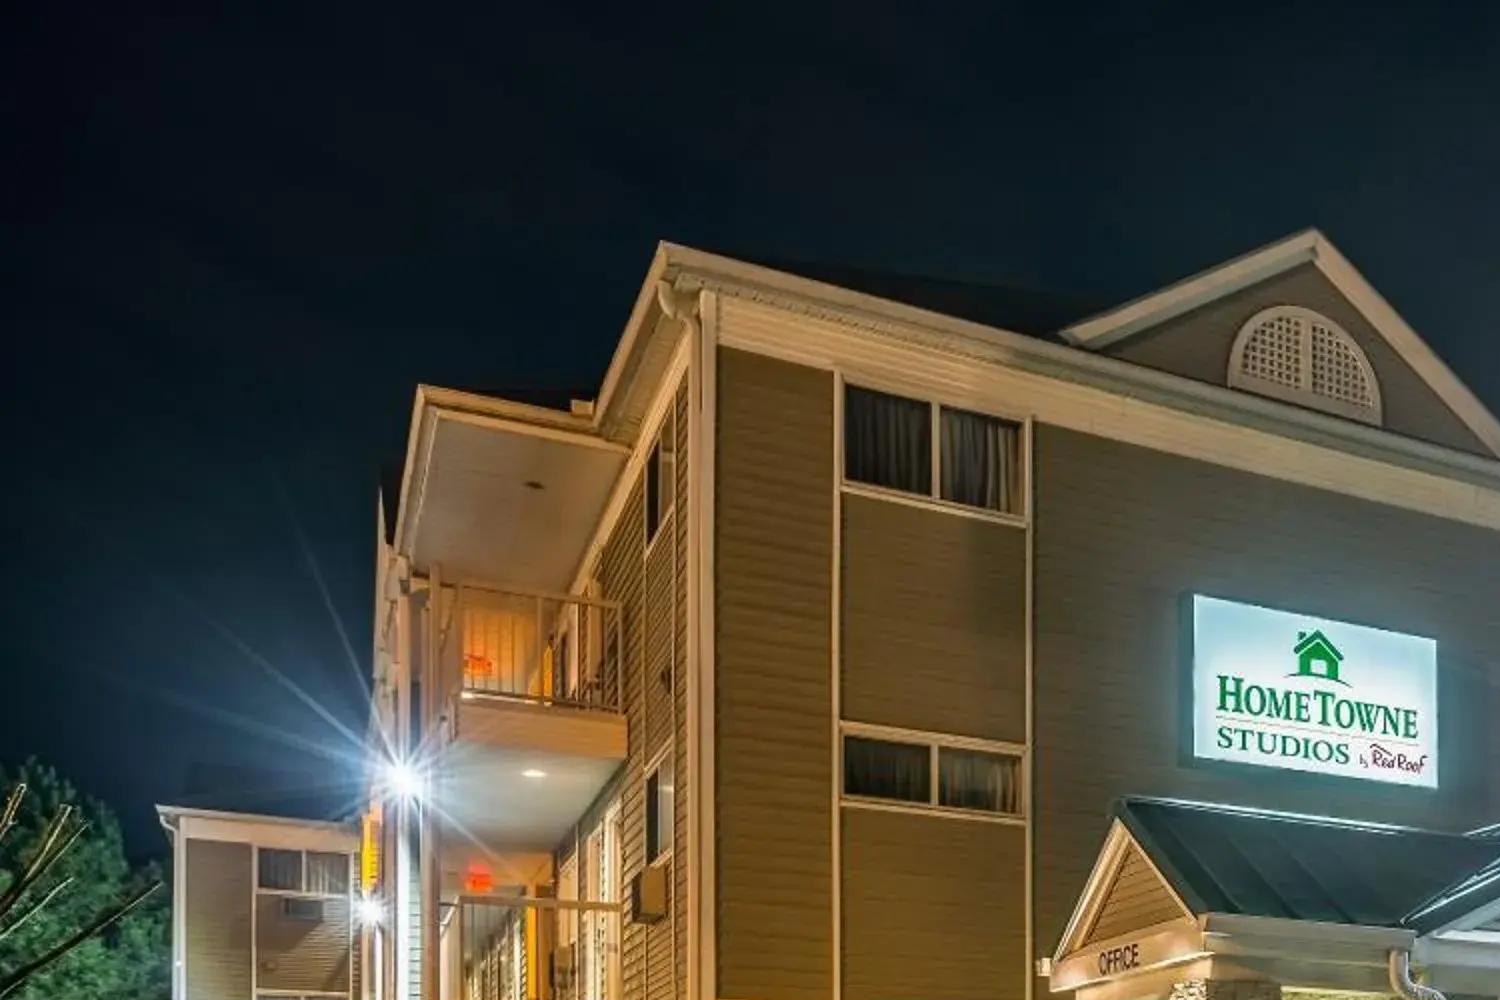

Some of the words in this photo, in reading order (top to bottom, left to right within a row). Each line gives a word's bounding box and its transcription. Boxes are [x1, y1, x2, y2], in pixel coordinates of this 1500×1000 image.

[1217, 726, 1350, 765] STUDIOS
[1359, 753, 1369, 769] by
[1099, 943, 1139, 976] OFFICE
